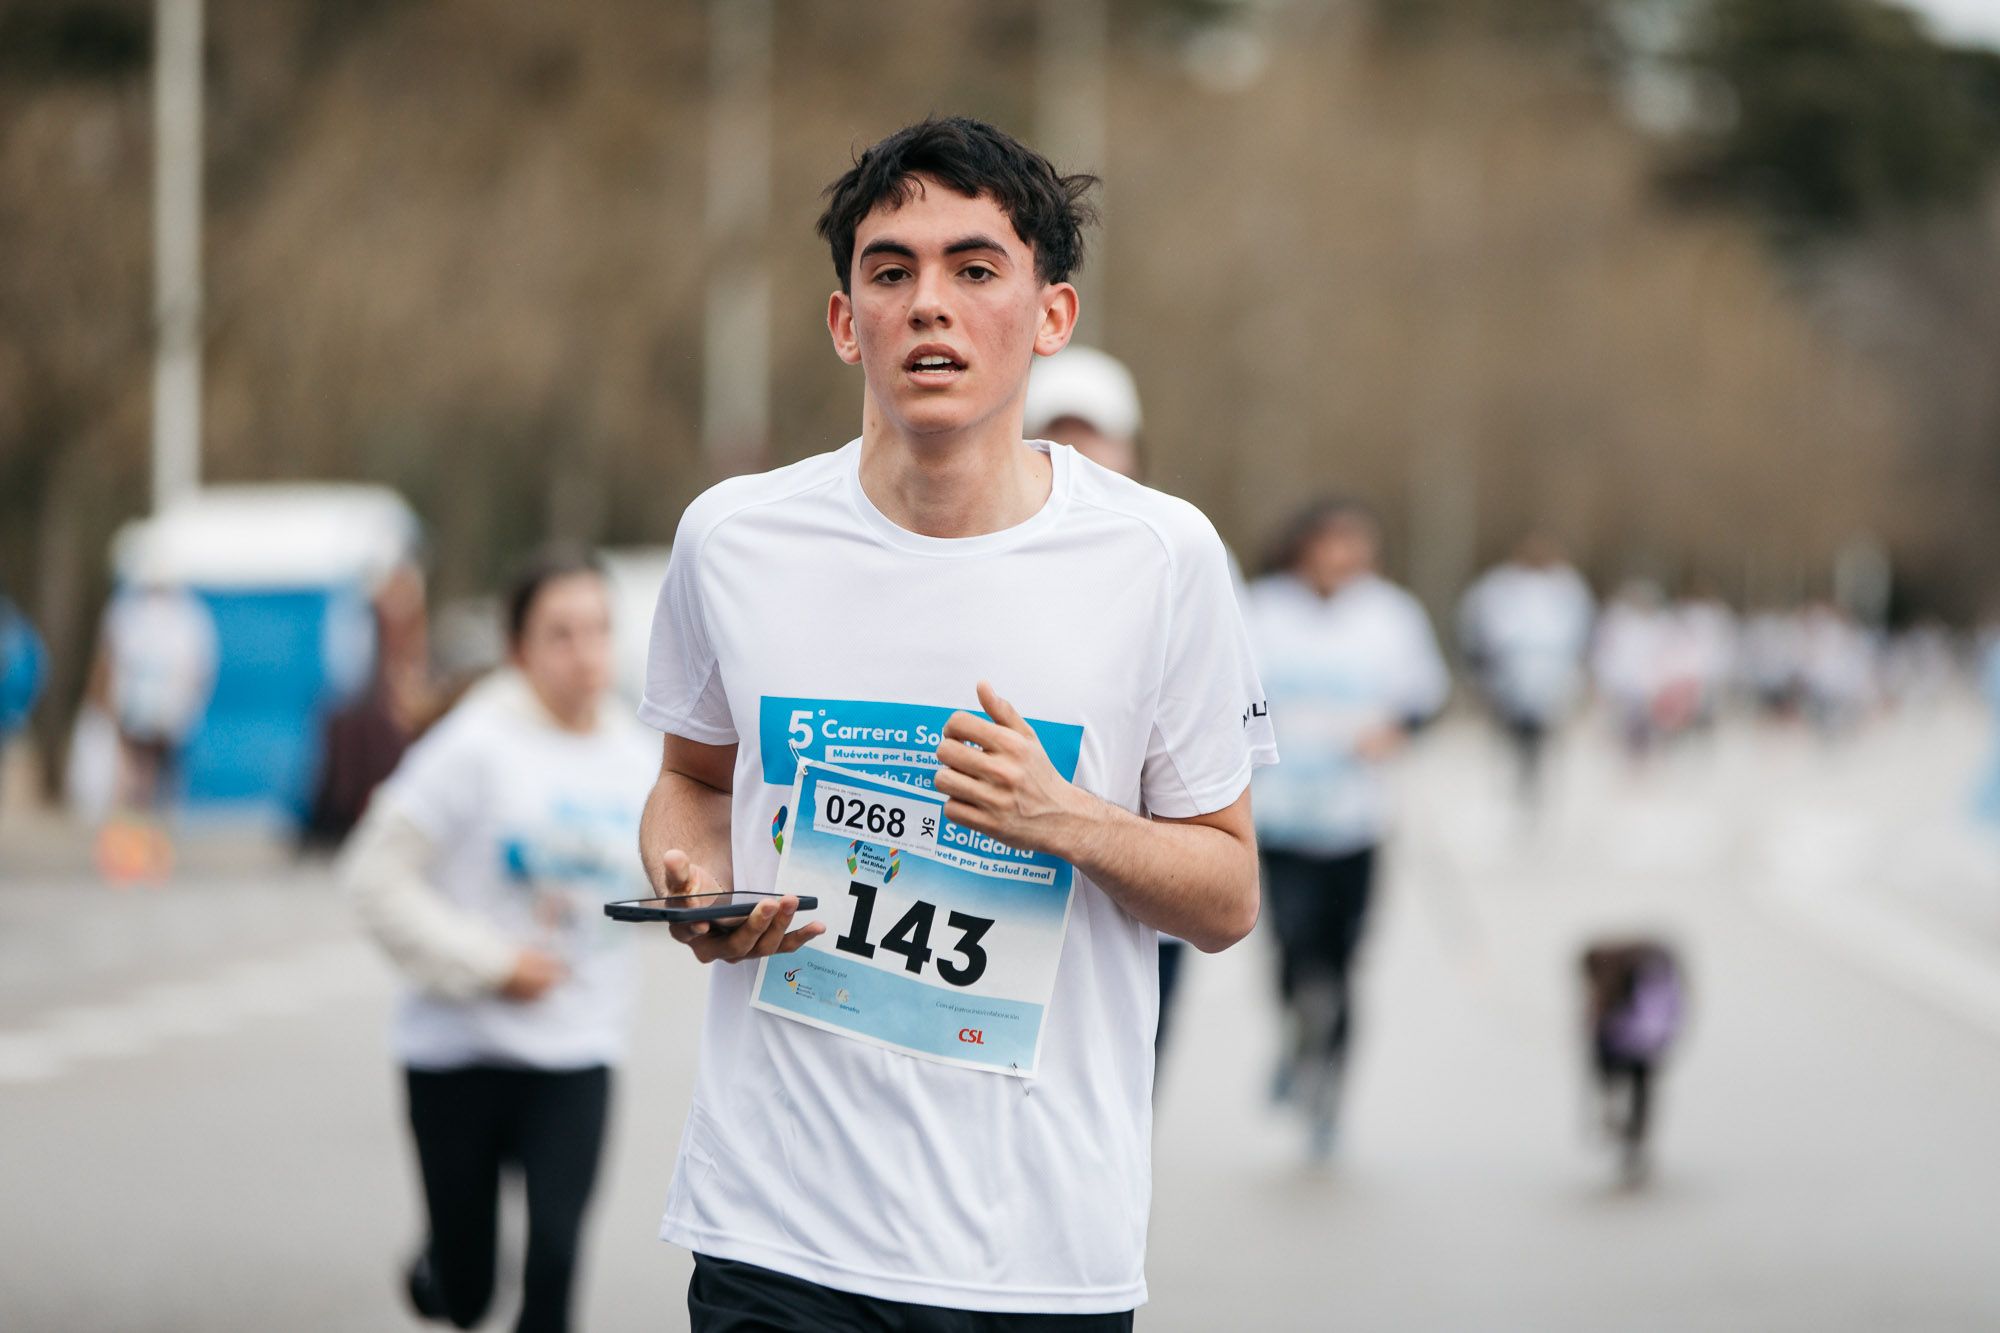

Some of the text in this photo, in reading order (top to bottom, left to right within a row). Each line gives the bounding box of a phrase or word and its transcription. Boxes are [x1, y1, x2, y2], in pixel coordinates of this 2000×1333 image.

[821, 719, 908, 743] Carrera
[832, 748, 879, 760] Muévete
[882, 753, 899, 763] por
[903, 752, 913, 761] la
[902, 772, 911, 785] 7
[914, 774, 931, 787] de
[826, 794, 906, 838] 0268
[920, 816, 935, 838] 5K
[861, 851, 886, 863] Mundial
[960, 857, 977, 867] por
[980, 861, 989, 871] la
[992, 863, 1020, 876] Salud
[1022, 867, 1051, 880] Renal
[835, 880, 995, 987] 143
[958, 1028, 984, 1045] CSL
